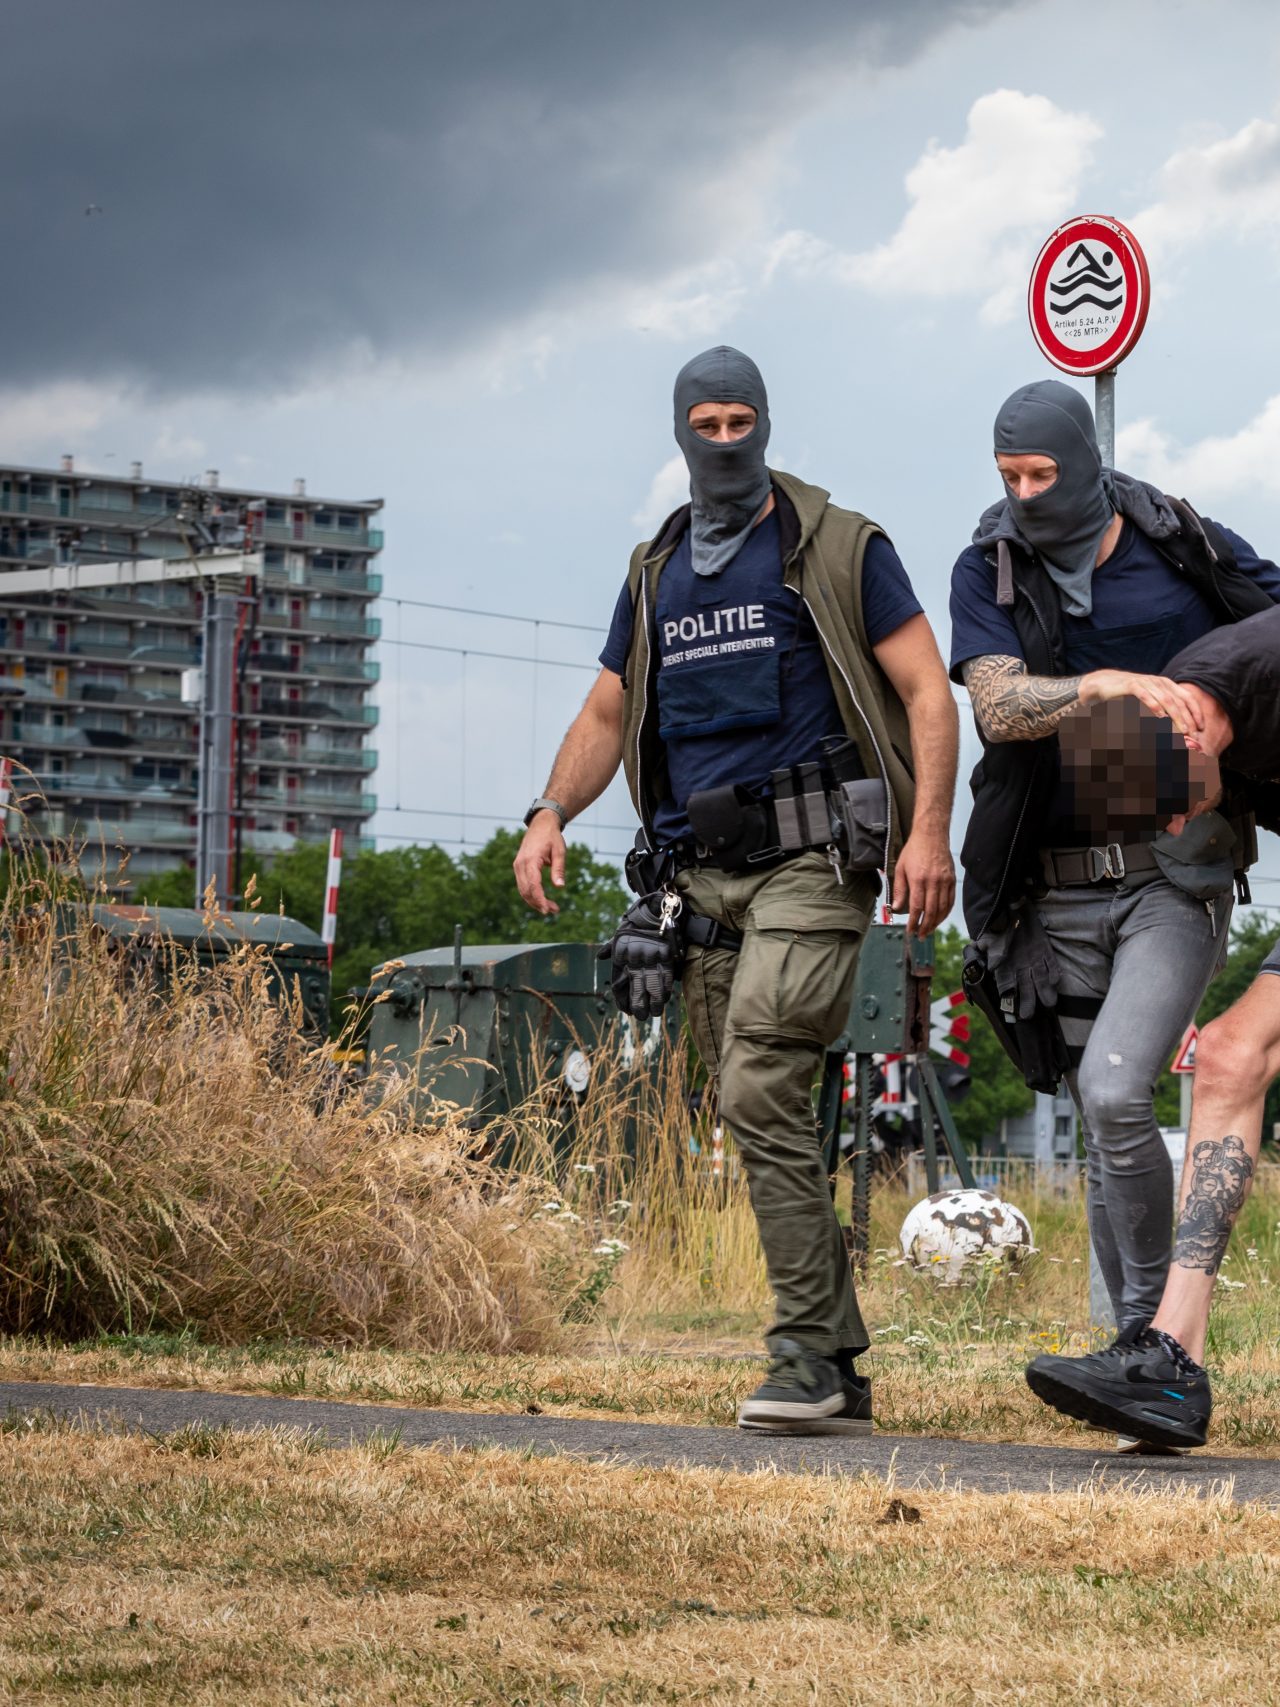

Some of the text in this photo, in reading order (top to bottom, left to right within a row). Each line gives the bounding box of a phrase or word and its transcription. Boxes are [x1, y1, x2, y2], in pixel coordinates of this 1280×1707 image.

[1054, 319, 1077, 329] Artikel
[1079, 318, 1094, 327] 5.24
[664, 604, 766, 647] POLITIE
[662, 636, 776, 667] DIENST SPECIALE INTERVENTIES
